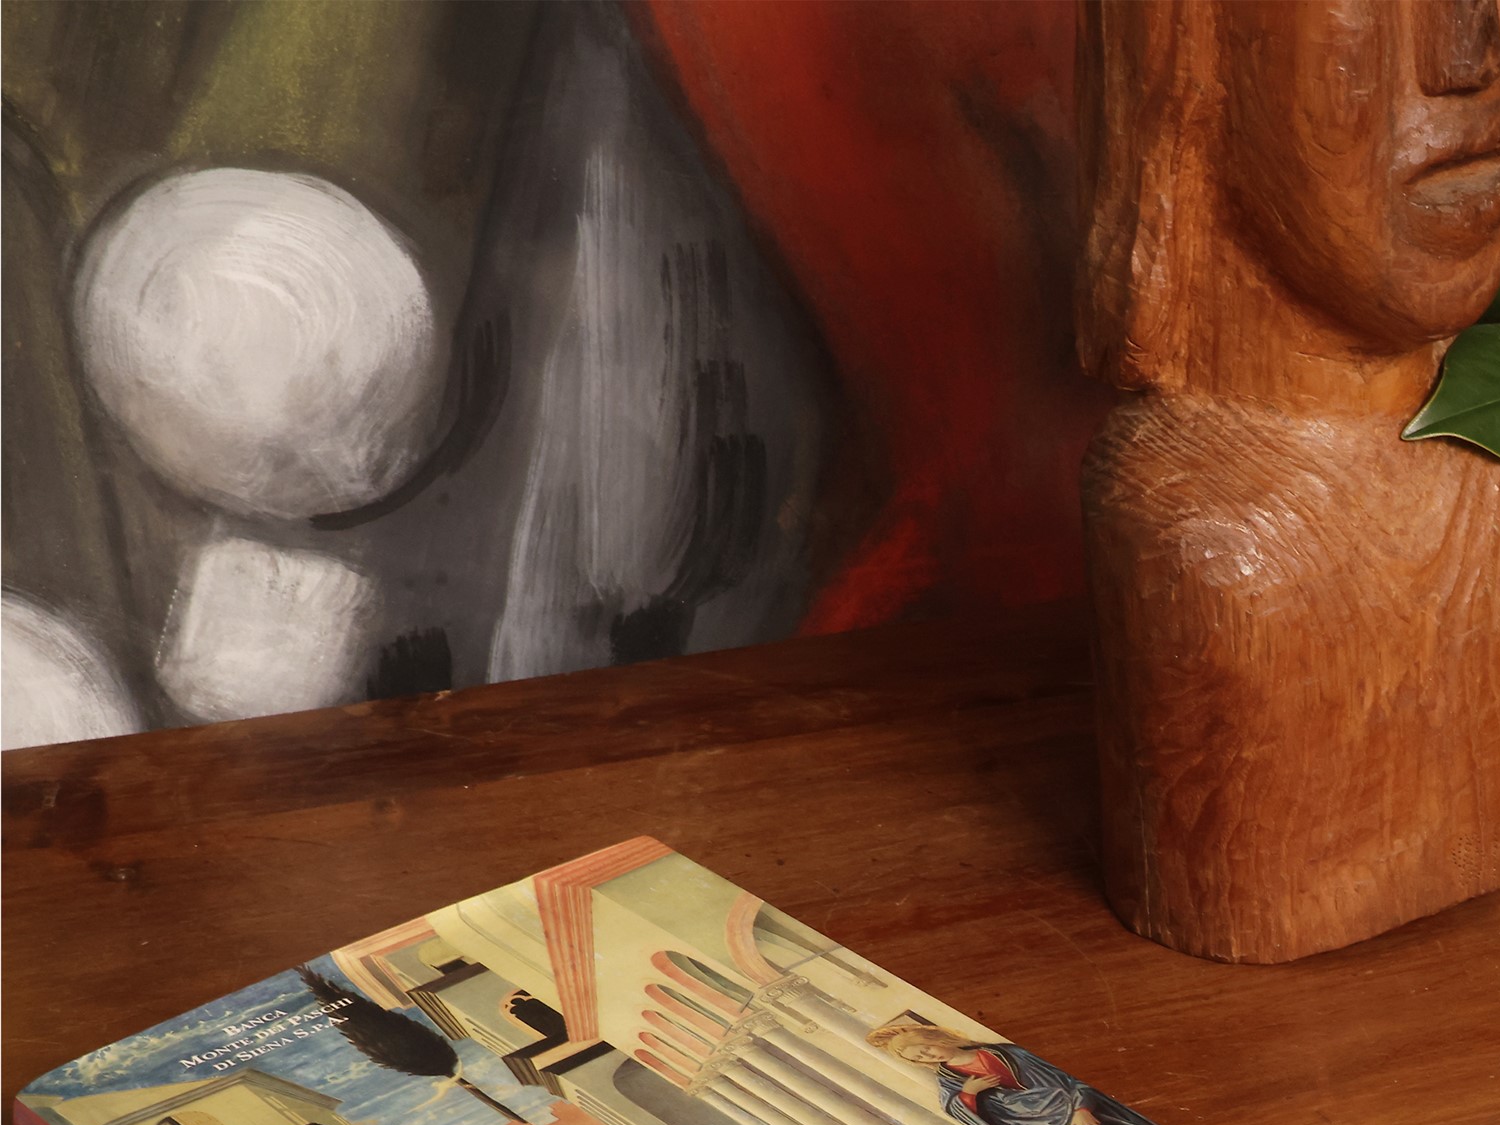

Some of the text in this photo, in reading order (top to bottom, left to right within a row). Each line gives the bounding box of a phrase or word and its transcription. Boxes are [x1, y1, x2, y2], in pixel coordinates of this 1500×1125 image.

[179, 998, 353, 1069] MONTE DEI PASCHI
[222, 1009, 288, 1037] BANCA
[213, 1057, 236, 1072] DI
[237, 1037, 294, 1062] SIENA
